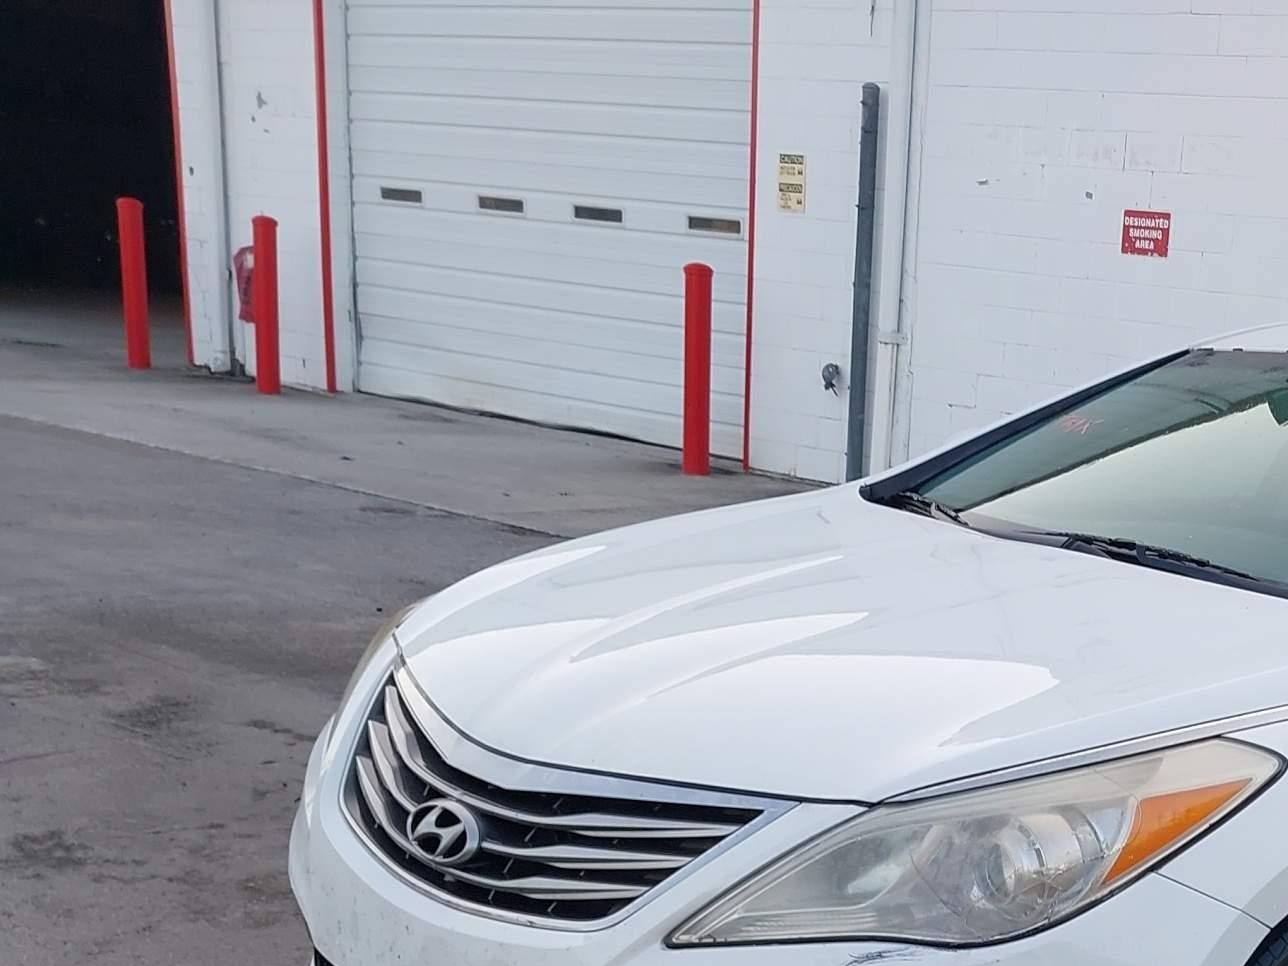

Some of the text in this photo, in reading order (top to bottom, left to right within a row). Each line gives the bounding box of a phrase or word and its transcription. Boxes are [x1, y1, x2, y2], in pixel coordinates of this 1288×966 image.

[1124, 216, 1169, 228] DESIGNATED
[1129, 228, 1162, 240] SMOKING
[1135, 239, 1154, 249] AREA
